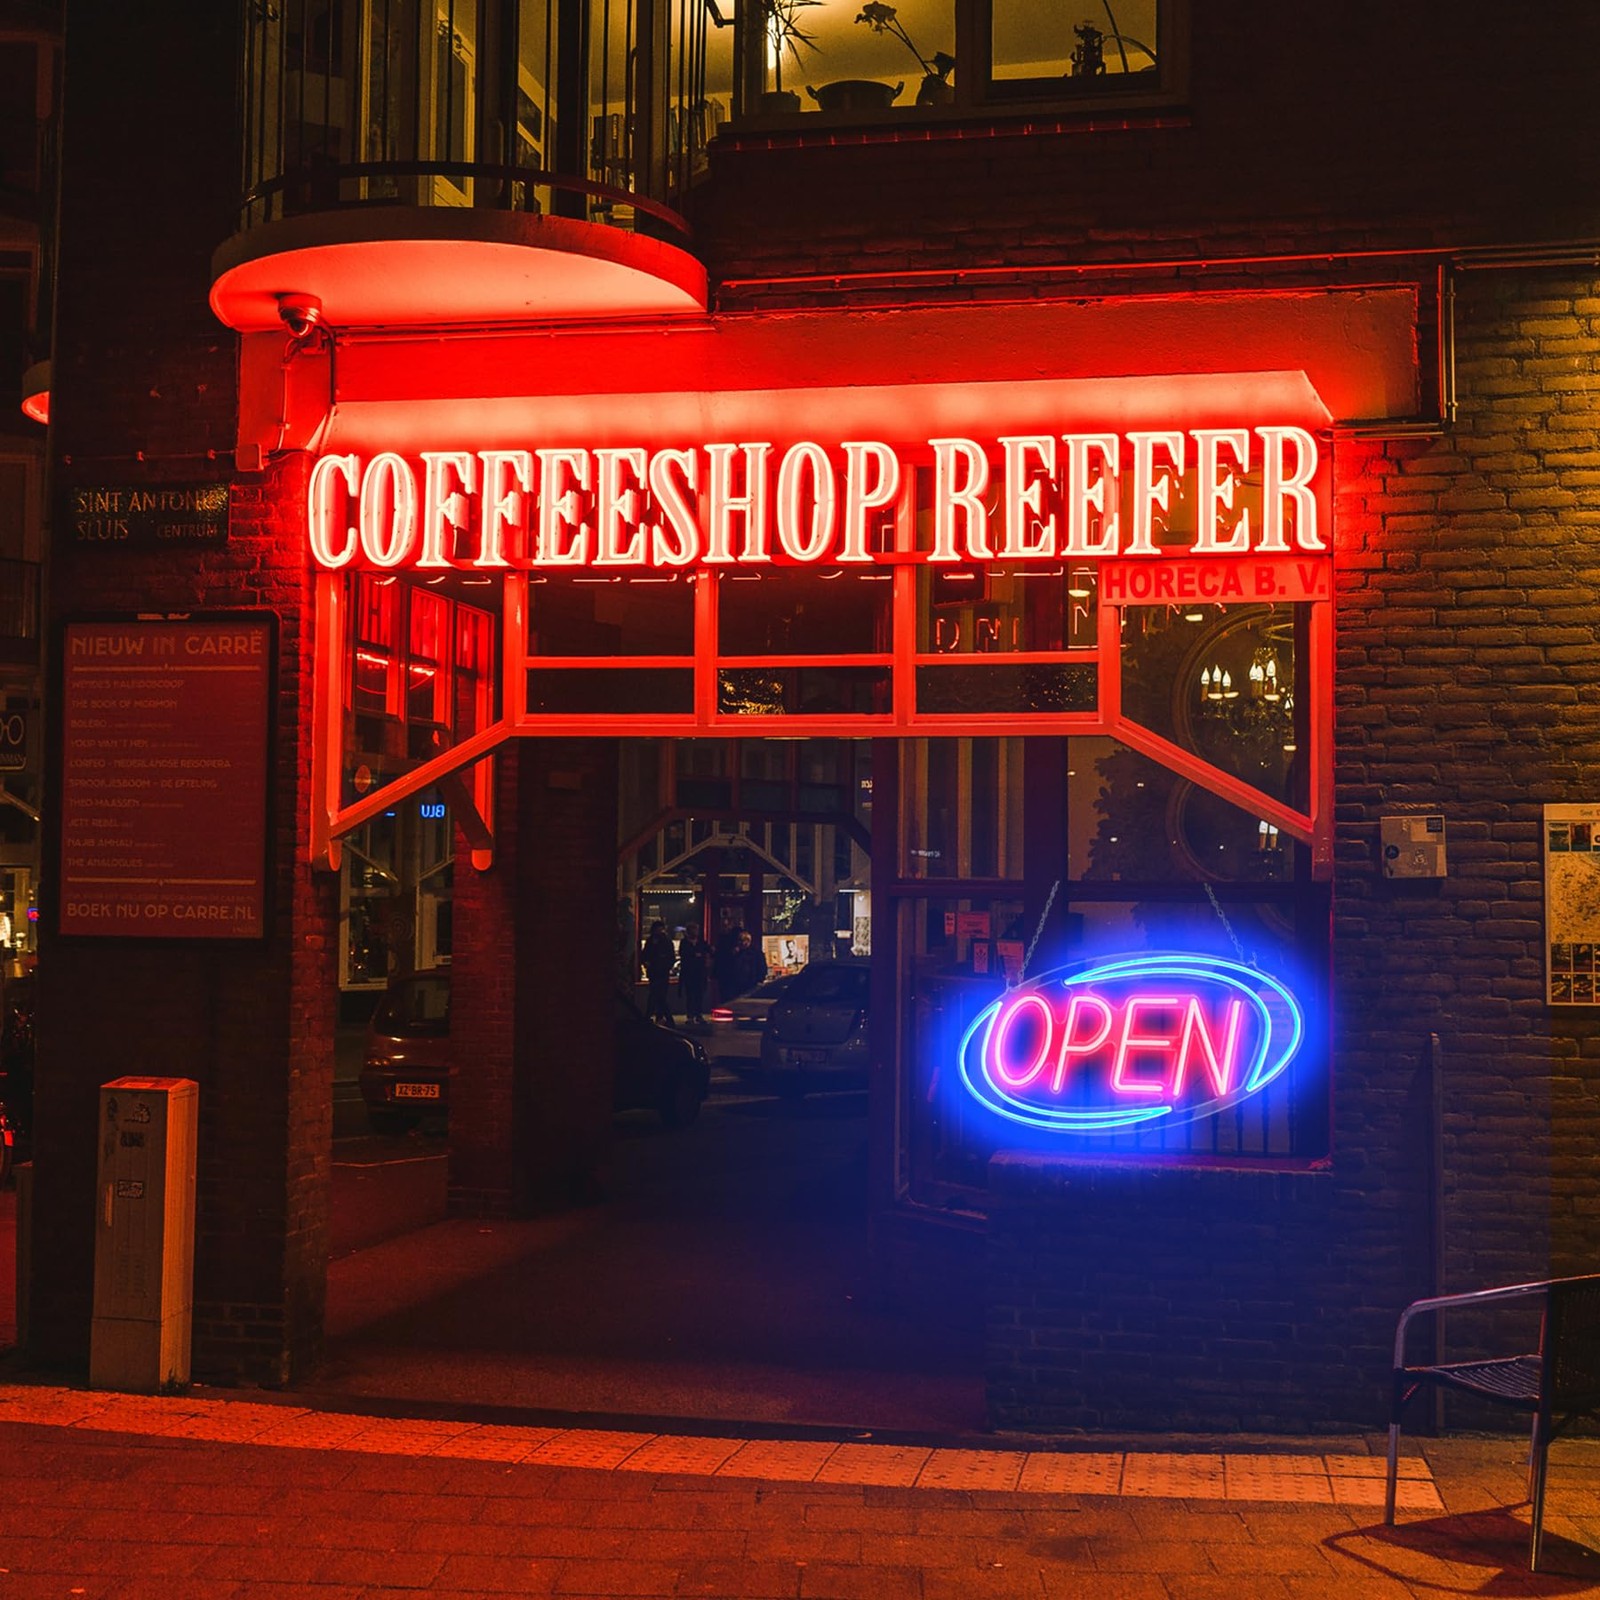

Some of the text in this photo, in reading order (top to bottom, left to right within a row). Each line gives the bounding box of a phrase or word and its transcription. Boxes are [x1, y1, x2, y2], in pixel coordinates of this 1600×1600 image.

[77, 491, 122, 513] SINT
[308, 425, 1326, 568] COFFEESHOP REEFER
[76, 519, 218, 540] SLUIS CENTRUM
[1105, 561, 1327, 598] HORECA B. V.
[71, 635, 145, 656] NIEUW
[152, 635, 176, 655] IN
[66, 902, 256, 921] BOEK NU OP CARRE.NL
[994, 995, 1241, 1096] OPEN
